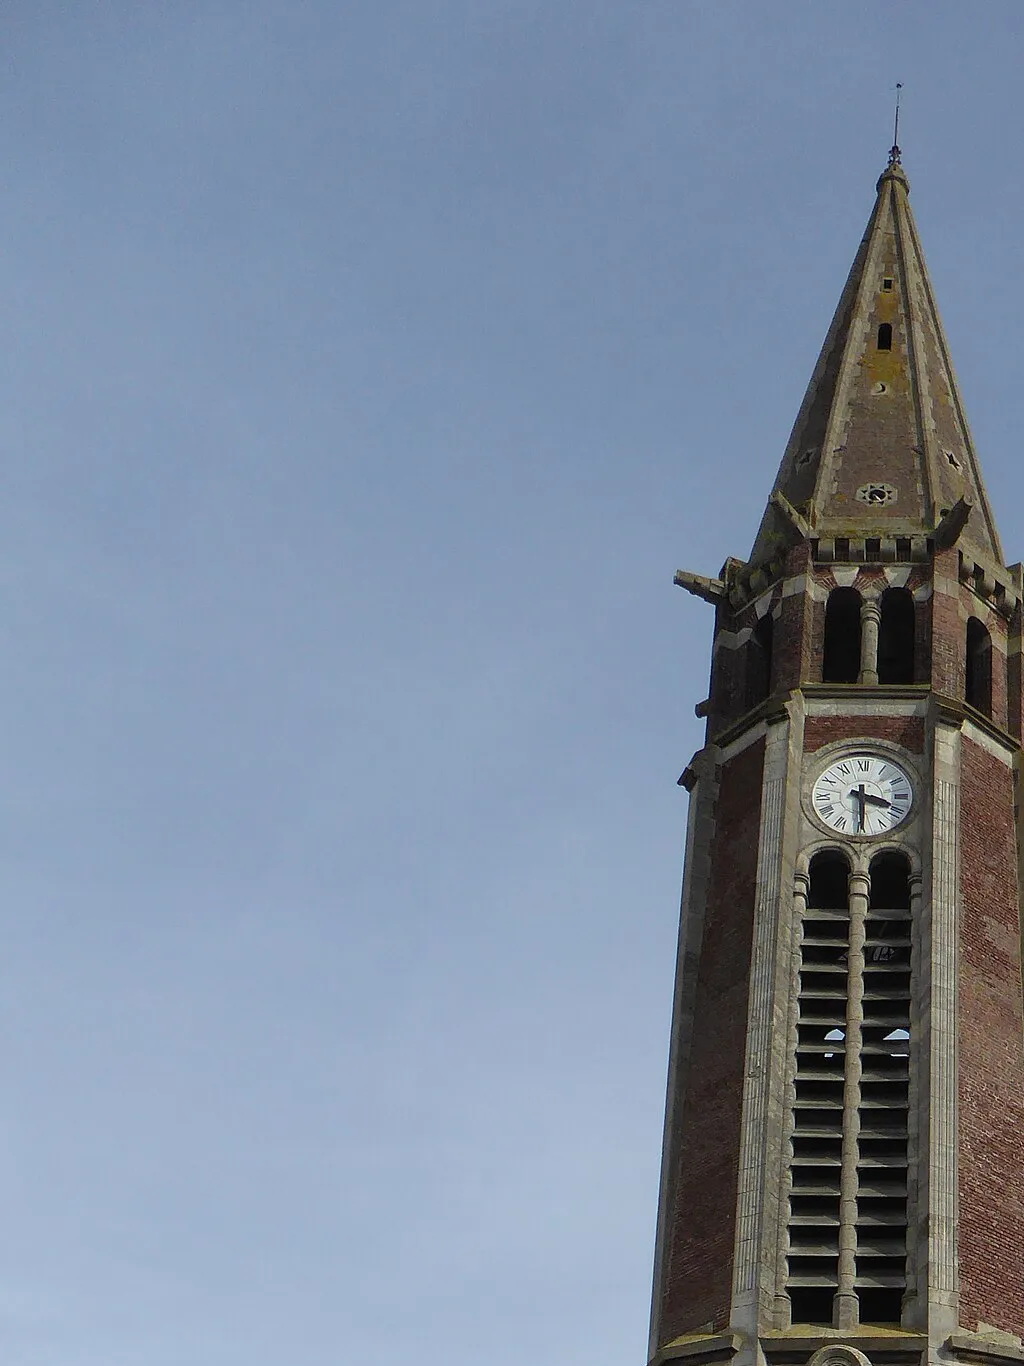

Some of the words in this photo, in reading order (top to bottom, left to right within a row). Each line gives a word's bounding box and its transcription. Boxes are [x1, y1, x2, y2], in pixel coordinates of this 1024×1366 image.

[837, 763, 851, 776] XI
[857, 760, 870, 772] XII
[822, 776, 837, 787] X
[889, 777, 904, 786] II
[815, 792, 831, 801] IX
